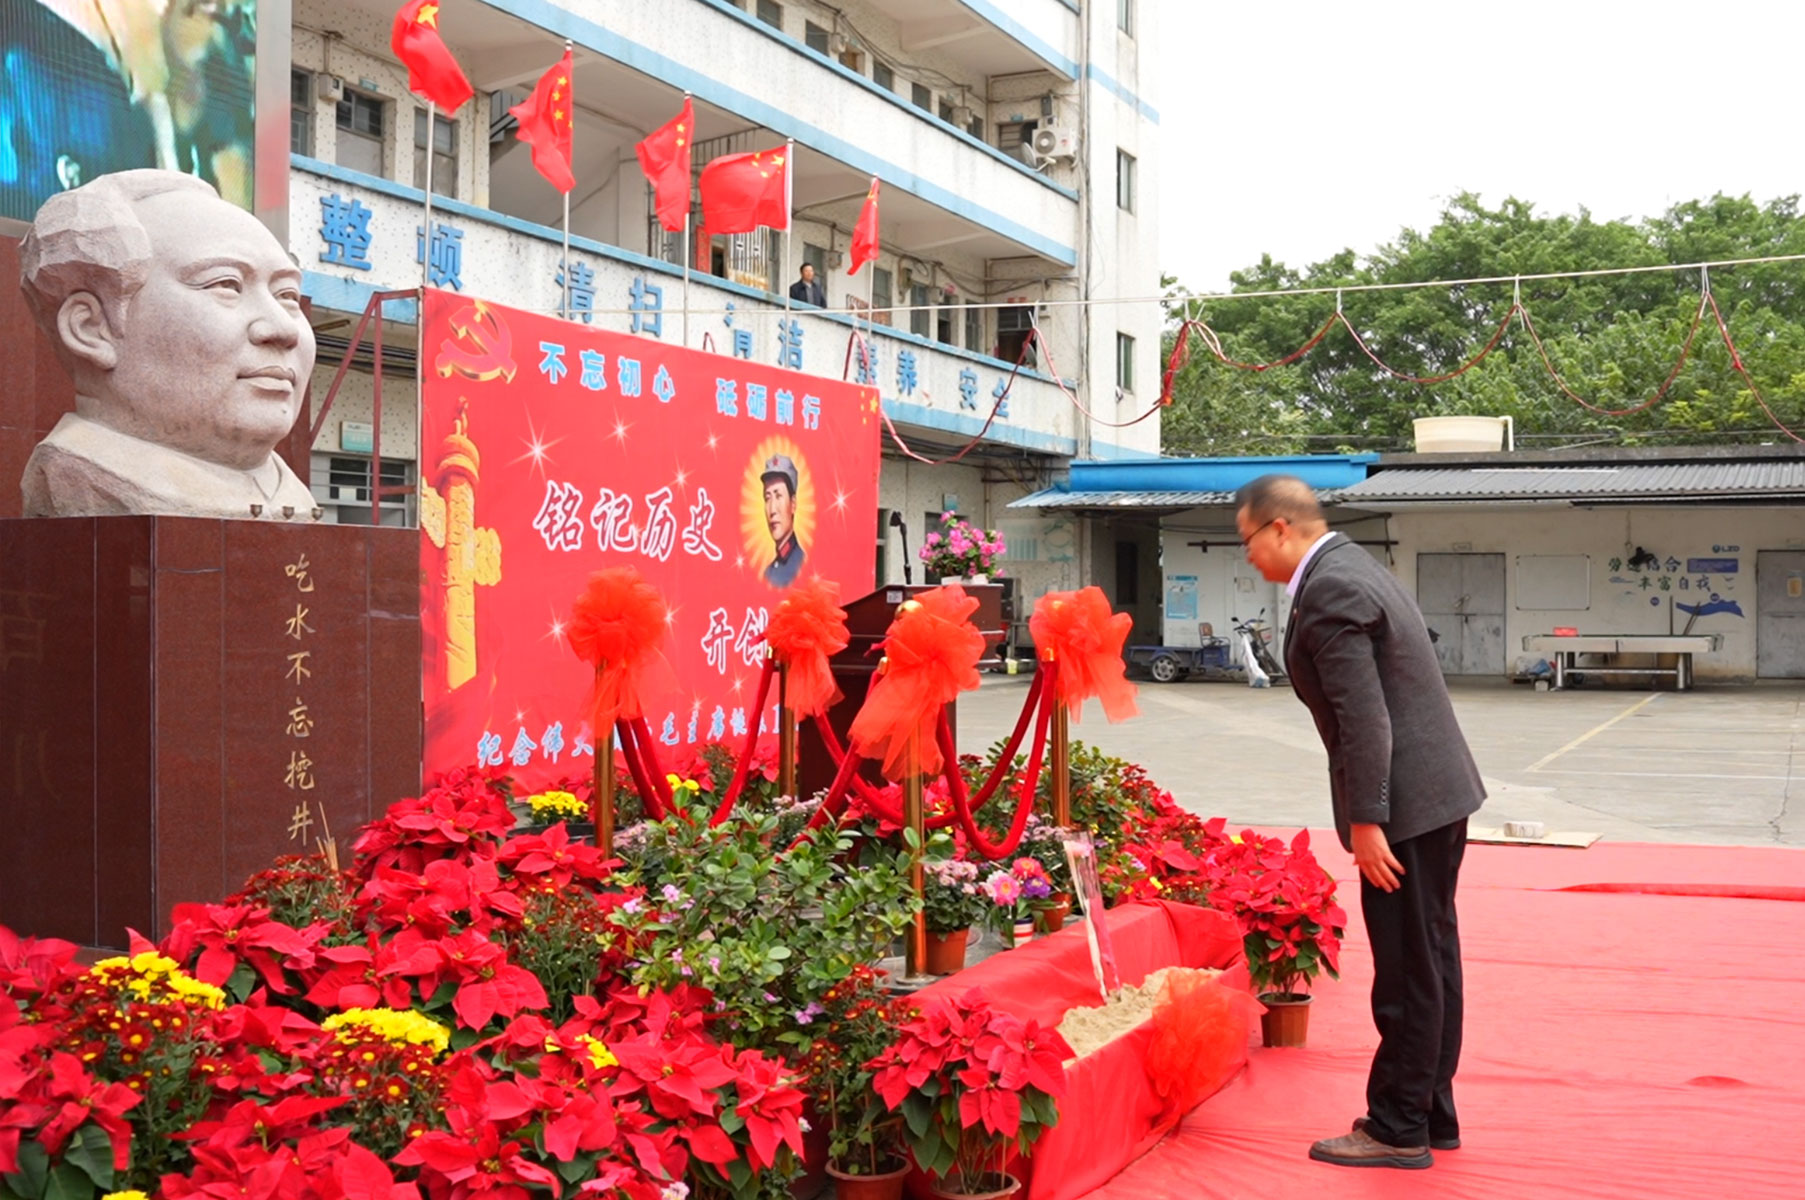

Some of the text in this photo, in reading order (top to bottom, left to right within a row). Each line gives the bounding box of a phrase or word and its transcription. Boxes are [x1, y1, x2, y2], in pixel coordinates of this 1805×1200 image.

[319, 193, 464, 290] 整顿
[555, 259, 663, 337] 清扫
[958, 366, 1010, 418] 安全
[539, 340, 821, 430] 不忘初心 砥砺前行
[532, 479, 723, 562] 铭记历史
[284, 553, 316, 846] 吃水不忘挖井
